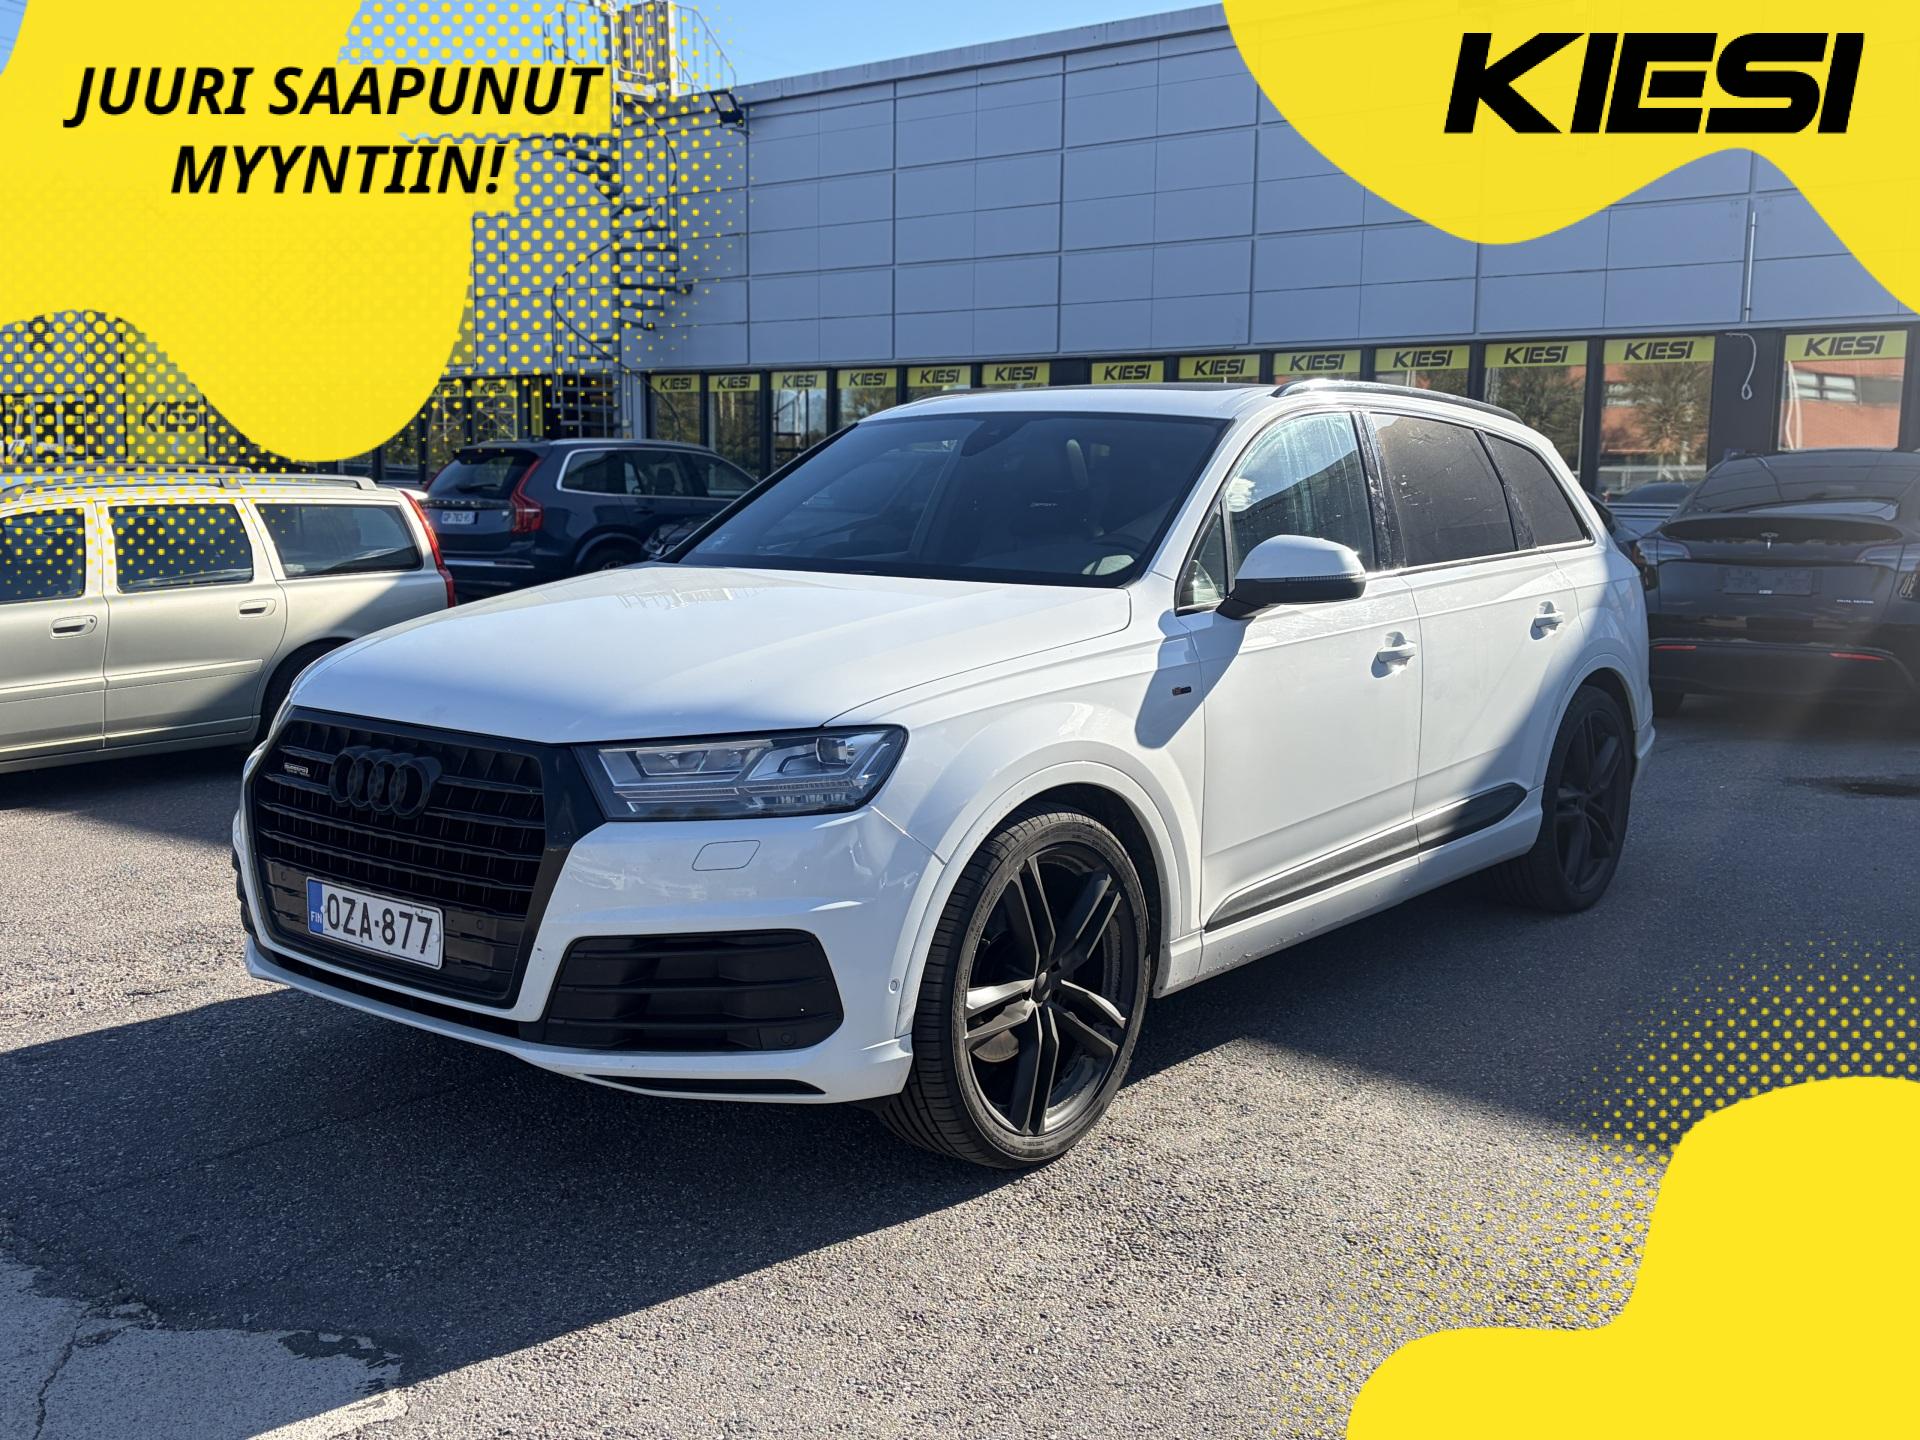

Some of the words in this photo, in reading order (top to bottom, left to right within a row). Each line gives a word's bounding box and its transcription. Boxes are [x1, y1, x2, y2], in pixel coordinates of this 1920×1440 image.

[1623, 340, 1694, 361] KIESI
[1803, 335, 1885, 357] KIESI
[1289, 353, 1345, 371] KIESI
[1392, 349, 1453, 368] KIESI
[1503, 345, 1568, 365] KIESI
[994, 366, 1038, 382] KIESI
[1103, 364, 1151, 380] KIESI
[1193, 358, 1245, 376] KIESI
[660, 377, 692, 390] KIESI
[716, 375, 751, 390] KIESI
[781, 374, 817, 389] KIESI
[848, 372, 887, 387] KIESI
[919, 369, 960, 384] KIESI
[310, 911, 323, 924] FIN
[327, 893, 433, 954] OZA-877
